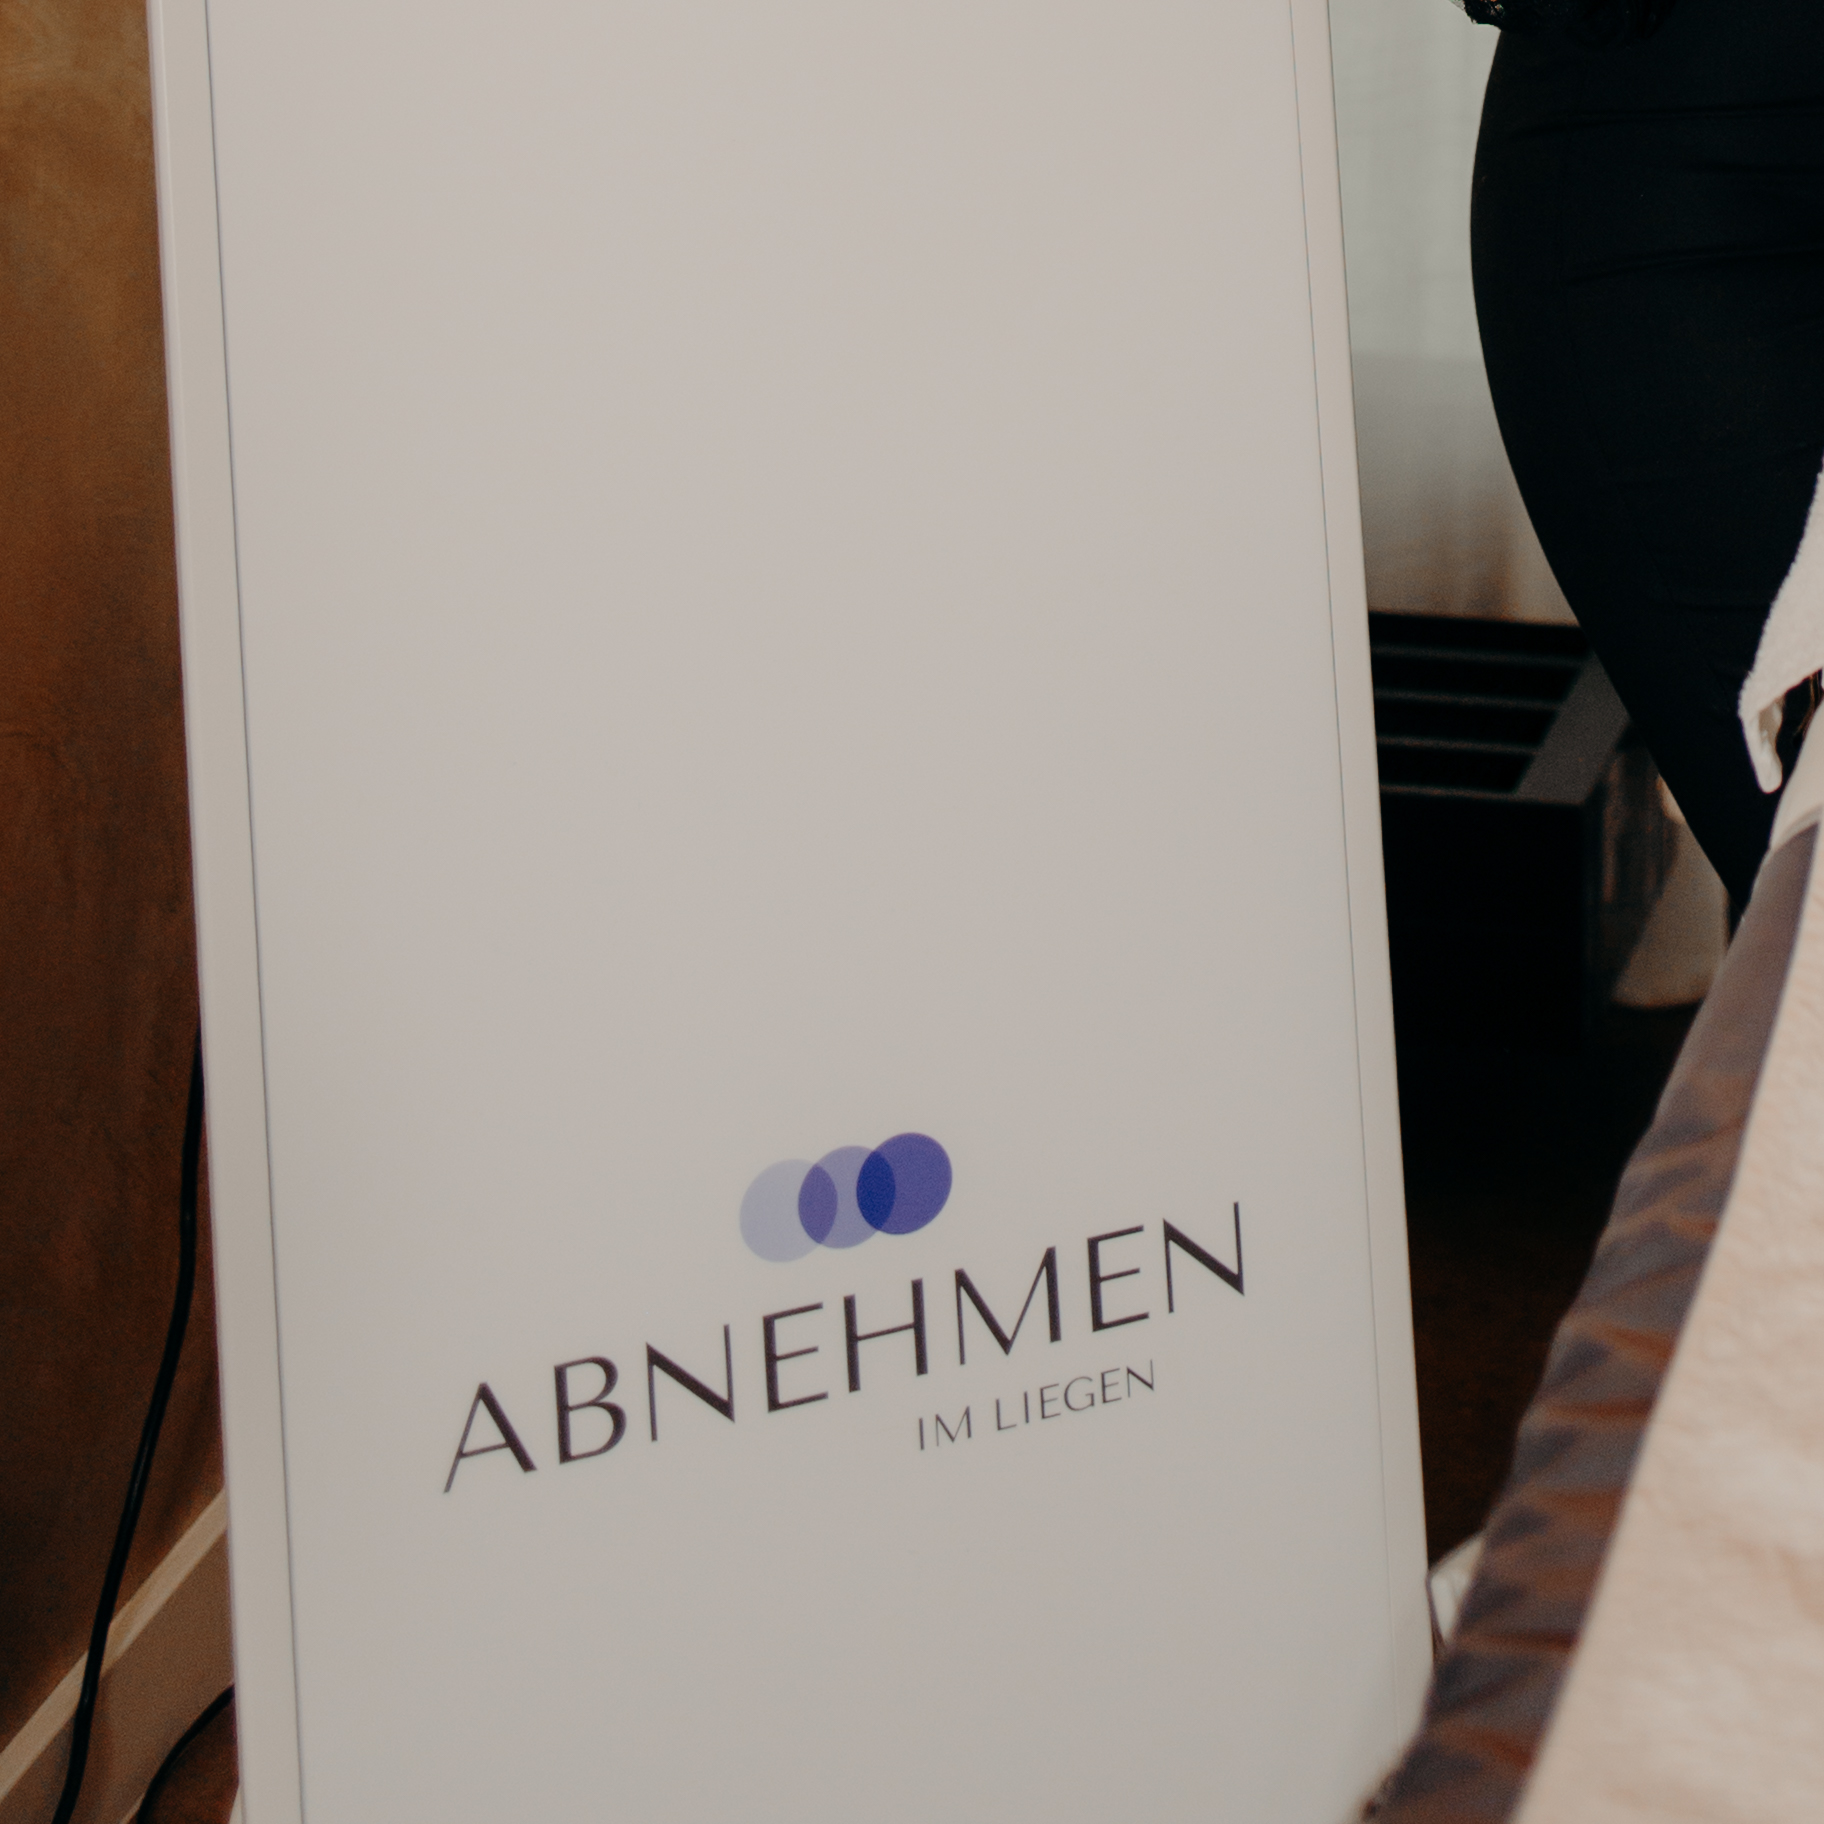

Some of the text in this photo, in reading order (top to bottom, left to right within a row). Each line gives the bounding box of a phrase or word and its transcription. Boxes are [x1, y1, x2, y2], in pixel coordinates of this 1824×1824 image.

[443, 1200, 1246, 1494] ABNEHMEN
[917, 1358, 1157, 1451] IM LIEGEN
